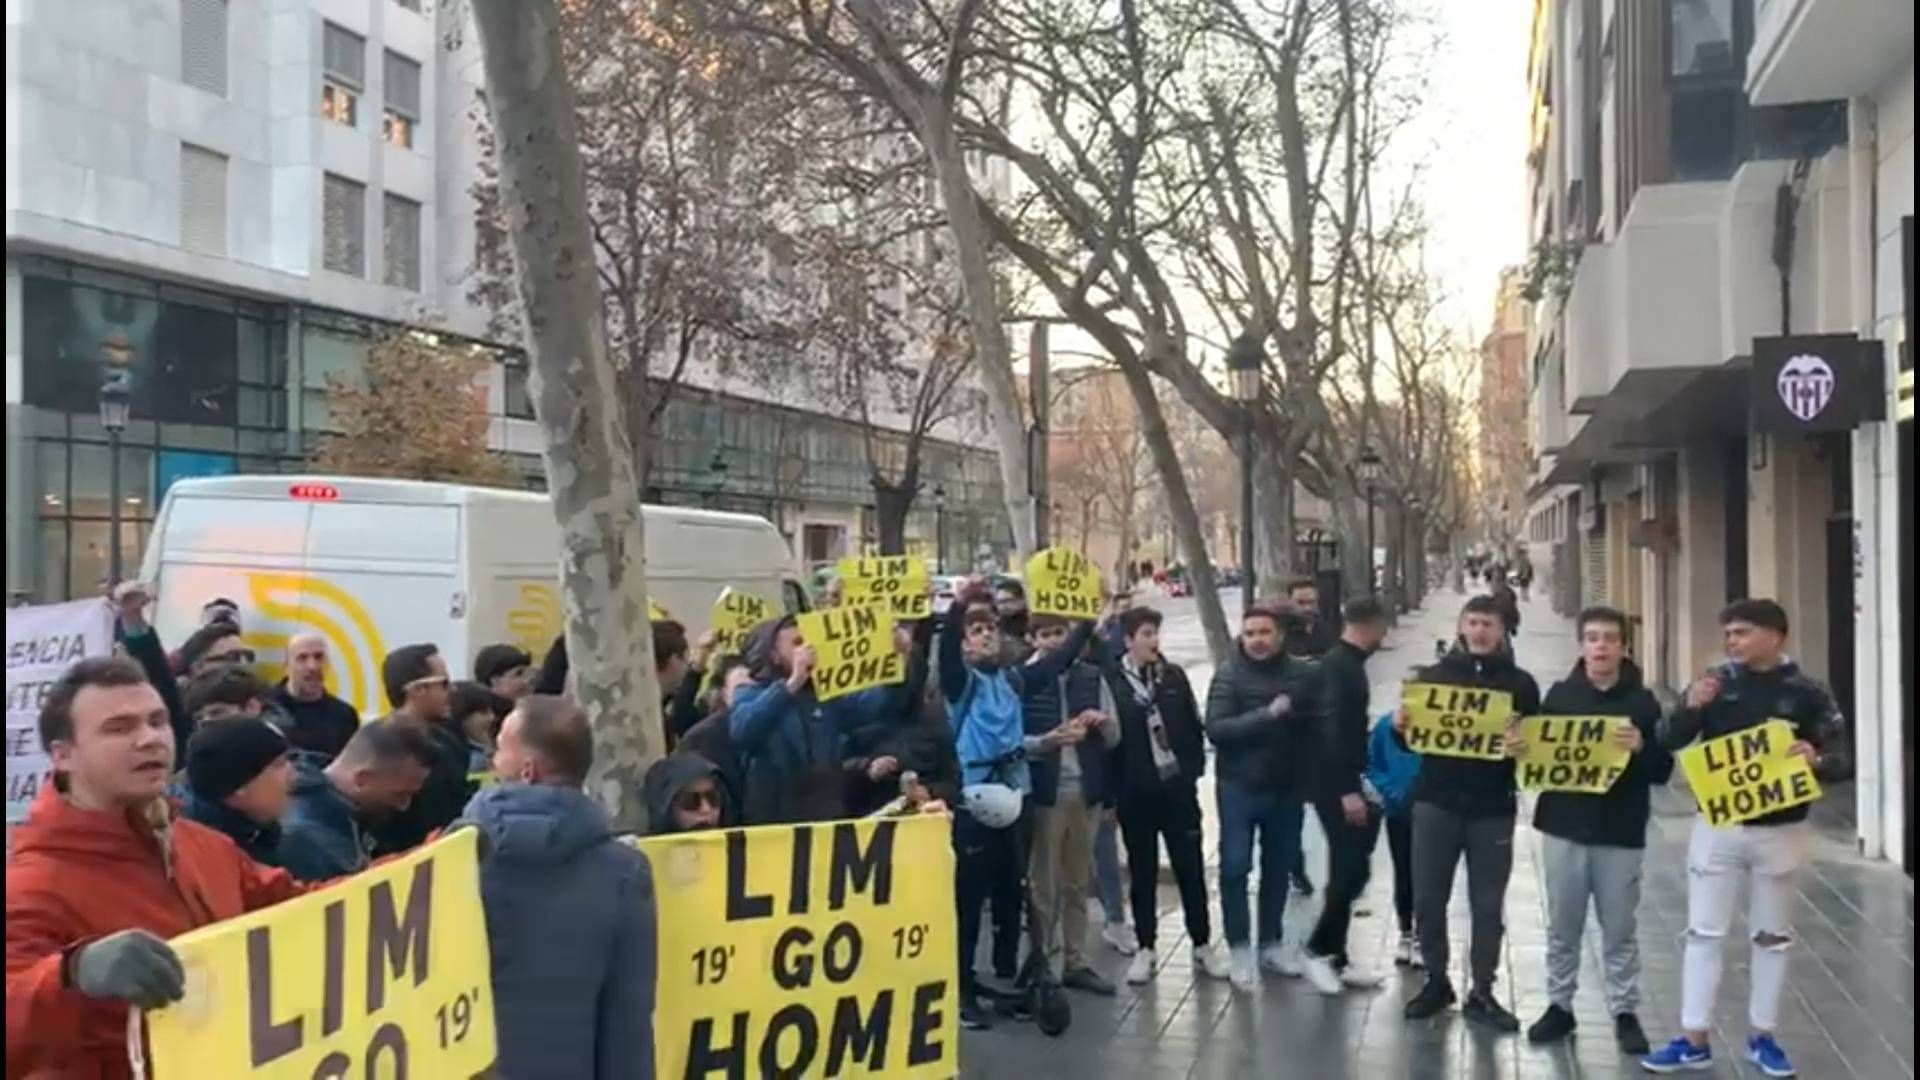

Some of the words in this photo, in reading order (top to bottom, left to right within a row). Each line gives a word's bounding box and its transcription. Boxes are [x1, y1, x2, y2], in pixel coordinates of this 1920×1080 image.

[858, 559, 908, 578] LIM
[1047, 551, 1088, 577] LIM
[871, 579, 900, 593] GO
[1056, 574, 1080, 591] GO
[725, 594, 763, 619] LIM
[823, 606, 877, 641] LIM
[841, 637, 871, 660] GO
[817, 651, 897, 693] HOME
[1426, 687, 1489, 715] LIM
[1439, 714, 1475, 730] GO
[1540, 719, 1606, 744] LIM
[1410, 726, 1505, 754] HOME
[1554, 745, 1591, 763] GO
[1704, 728, 1770, 773] LIM
[1728, 762, 1764, 787] GO
[1707, 770, 1812, 825] HOME
[725, 820, 898, 922] LIM
[246, 857, 435, 1069] LIM
[691, 945, 736, 985] 19'
[772, 921, 863, 990] GO
[892, 924, 930, 960] 19'
[436, 987, 479, 1051] 19'
[683, 979, 948, 1080] HOME
